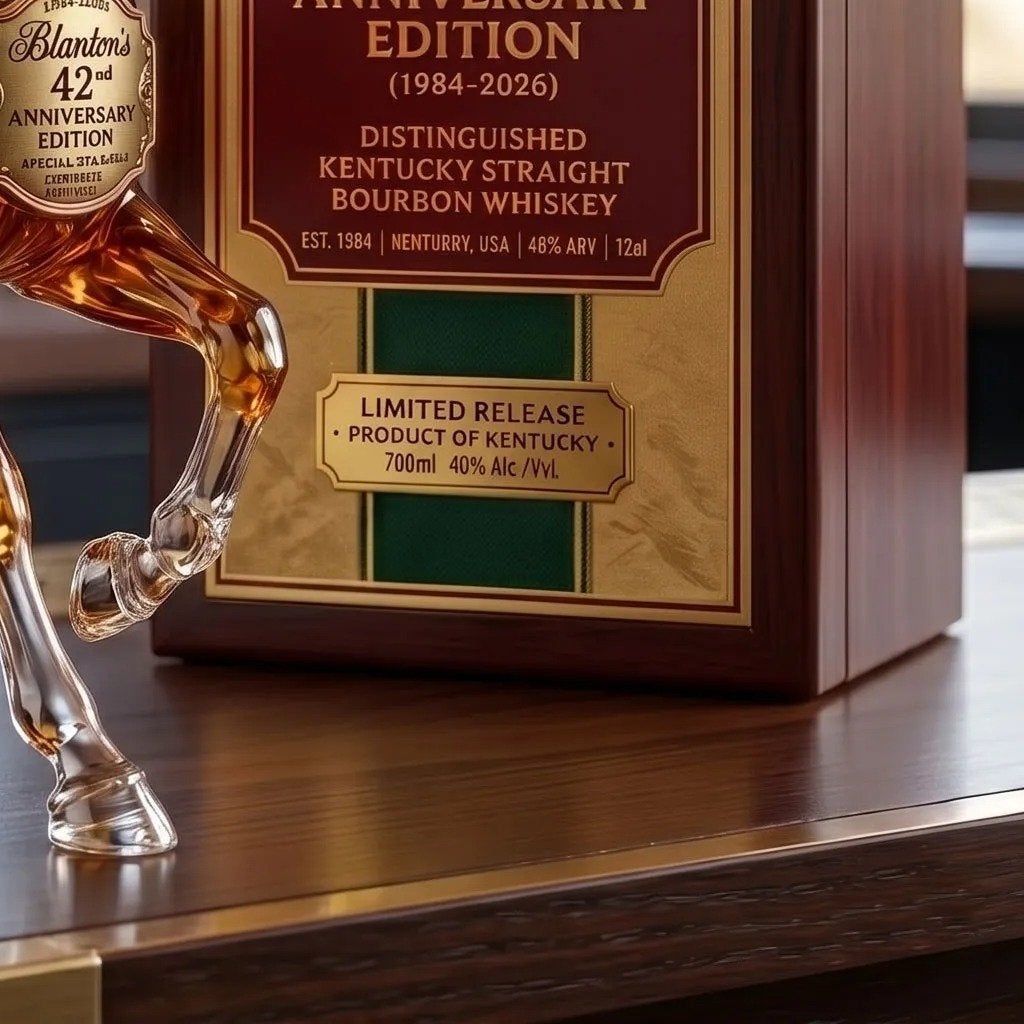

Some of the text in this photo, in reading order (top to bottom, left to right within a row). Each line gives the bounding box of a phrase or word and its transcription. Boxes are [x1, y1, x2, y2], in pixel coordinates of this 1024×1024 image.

[9, 21, 130, 63] Blanton's
[367, 21, 581, 59] EDITION
[390, 73, 557, 100] (1984-2026)
[8, 104, 136, 127] ANNIVERSARY
[38, 129, 112, 149] EDITION
[361, 126, 586, 150] DISTINGUISHED
[320, 157, 629, 184] KENTUCKY STRAIGHT
[333, 188, 617, 215] BOURBON WHISKEY
[302, 232, 331, 248] EST.
[338, 233, 371, 249] 1984
[392, 234, 473, 253] NENTURRY,
[480, 236, 509, 252] USA
[566, 238, 596, 254] ARV
[362, 398, 584, 425] LIMITED RELEASE
[350, 426, 598, 452] PRODUCT OF KENTUCKY
[386, 452, 435, 473] 700ml
[450, 456, 486, 475] 40%
[491, 457, 516, 476] Alc
